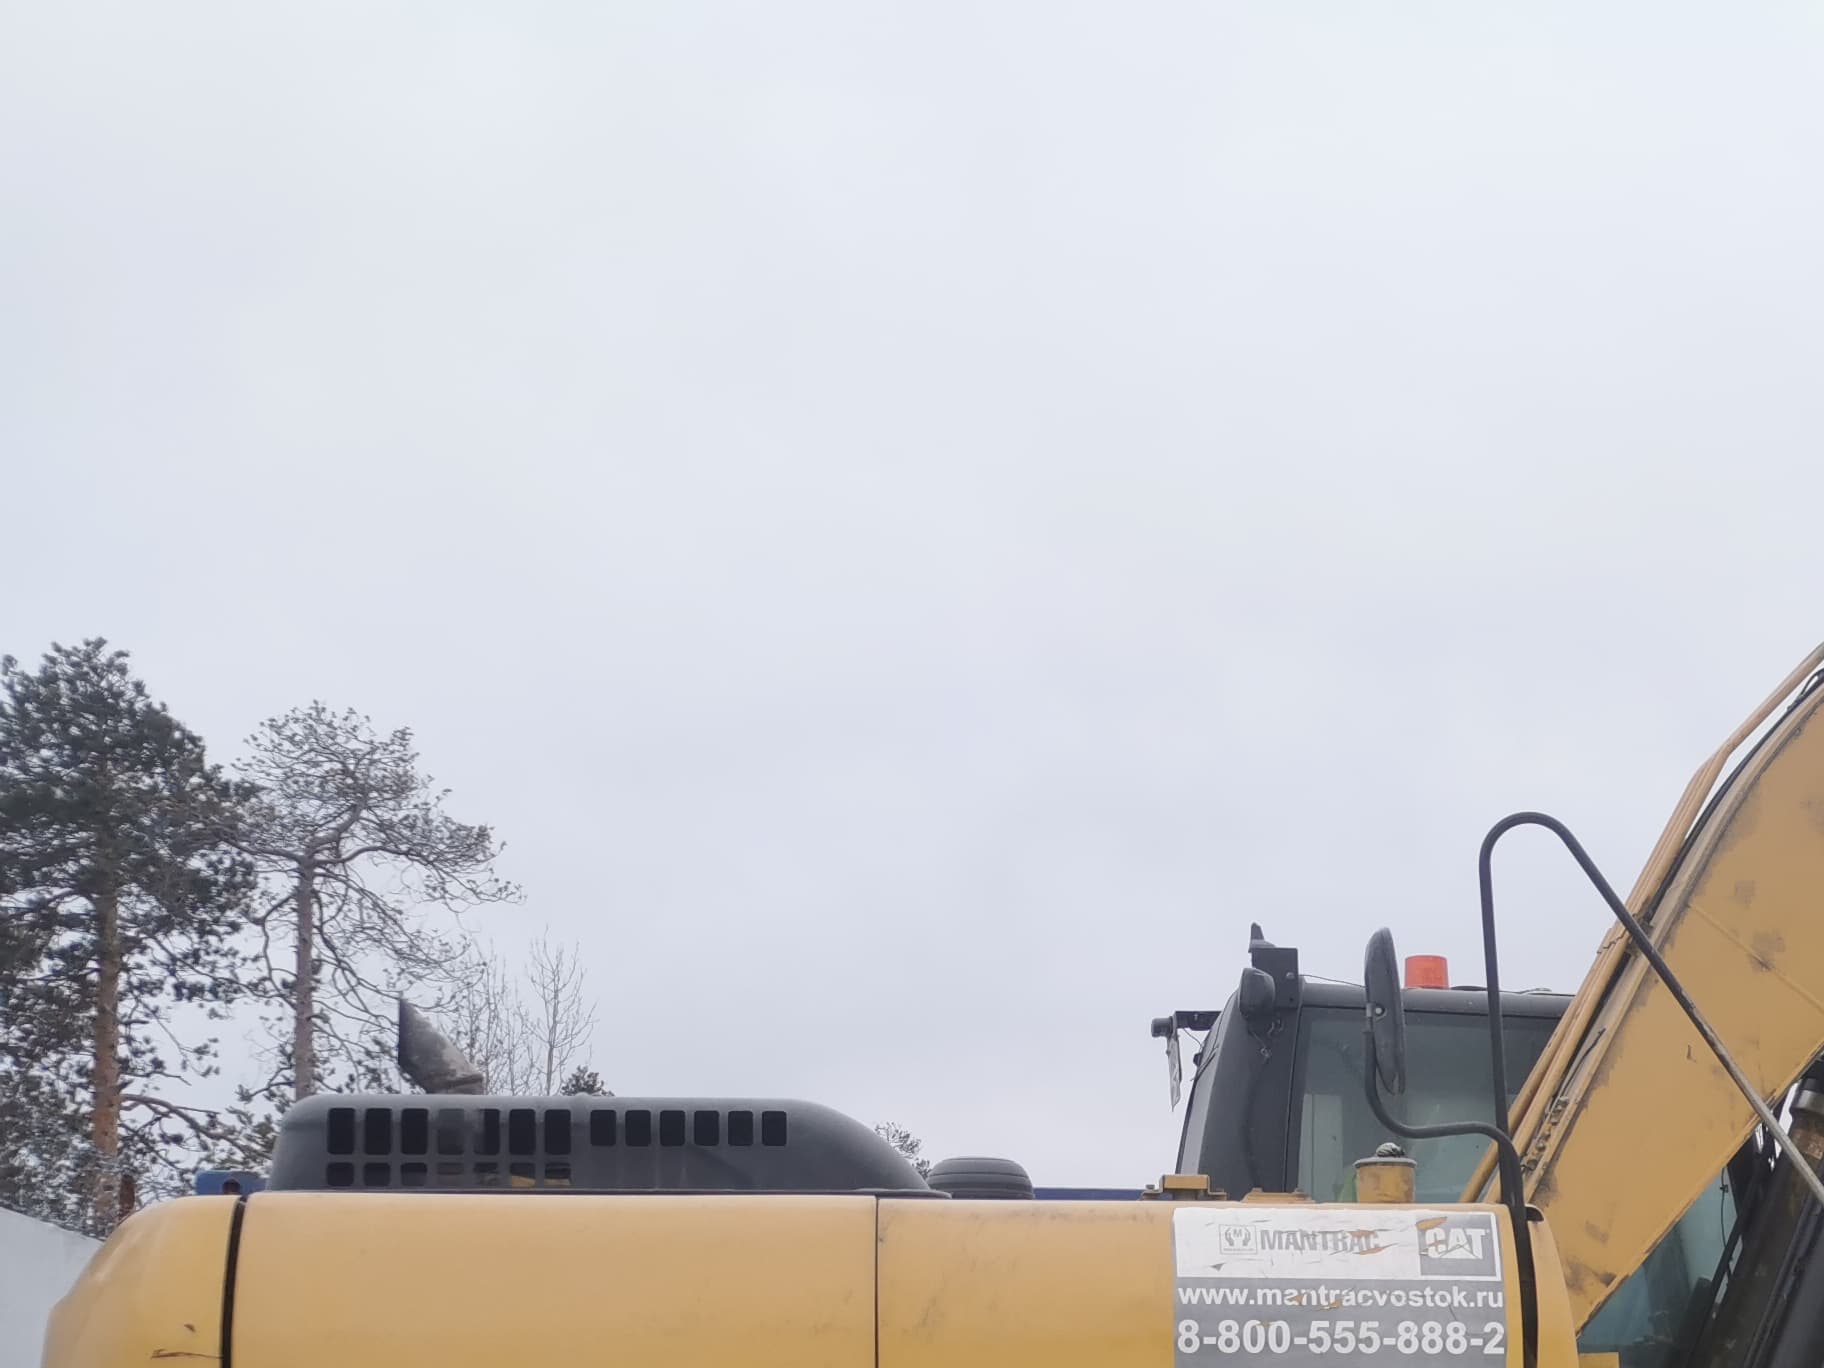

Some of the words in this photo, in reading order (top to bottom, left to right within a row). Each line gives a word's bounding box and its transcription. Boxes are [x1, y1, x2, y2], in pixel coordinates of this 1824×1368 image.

[1425, 1227, 1485, 1259] CAT
[1178, 1285, 1503, 1307] www.mantracvostok.ru
[1177, 1319, 1505, 1355] 8-800-555-888-2
